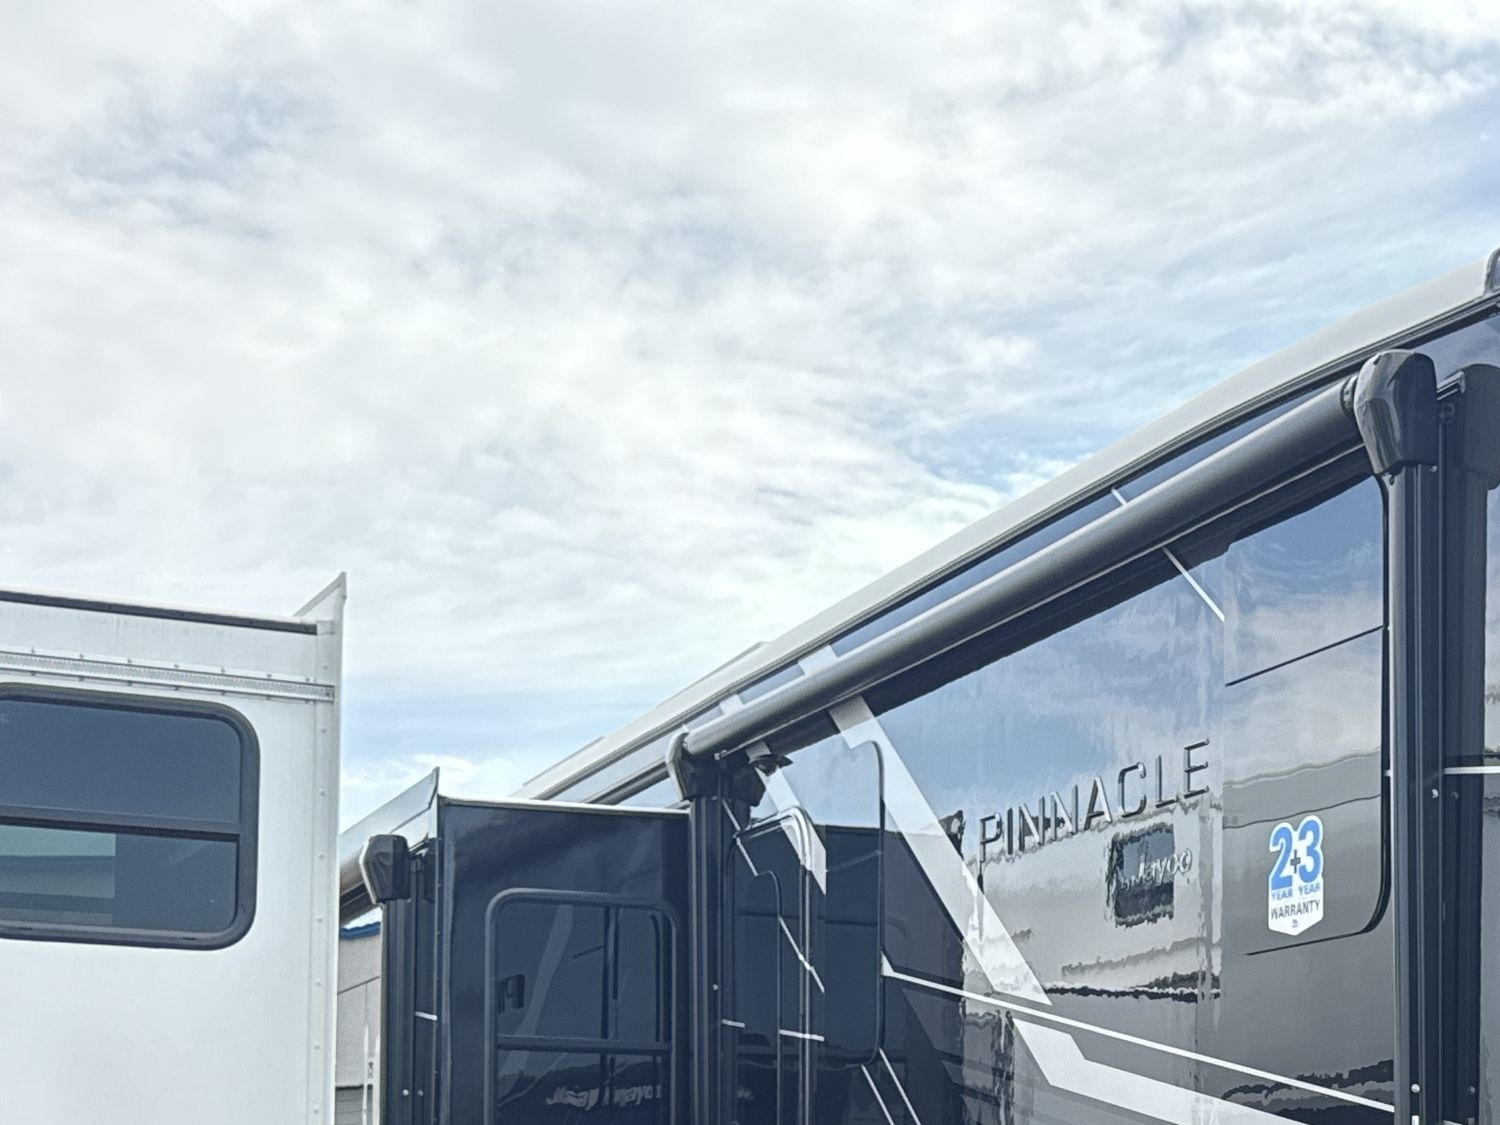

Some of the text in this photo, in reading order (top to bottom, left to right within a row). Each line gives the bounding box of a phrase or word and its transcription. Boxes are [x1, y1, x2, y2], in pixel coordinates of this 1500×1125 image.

[978, 737, 1210, 864] PINNACLE
[1272, 882, 1321, 901] YEAR YEAR
[1270, 899, 1321, 919] WARRANTY
